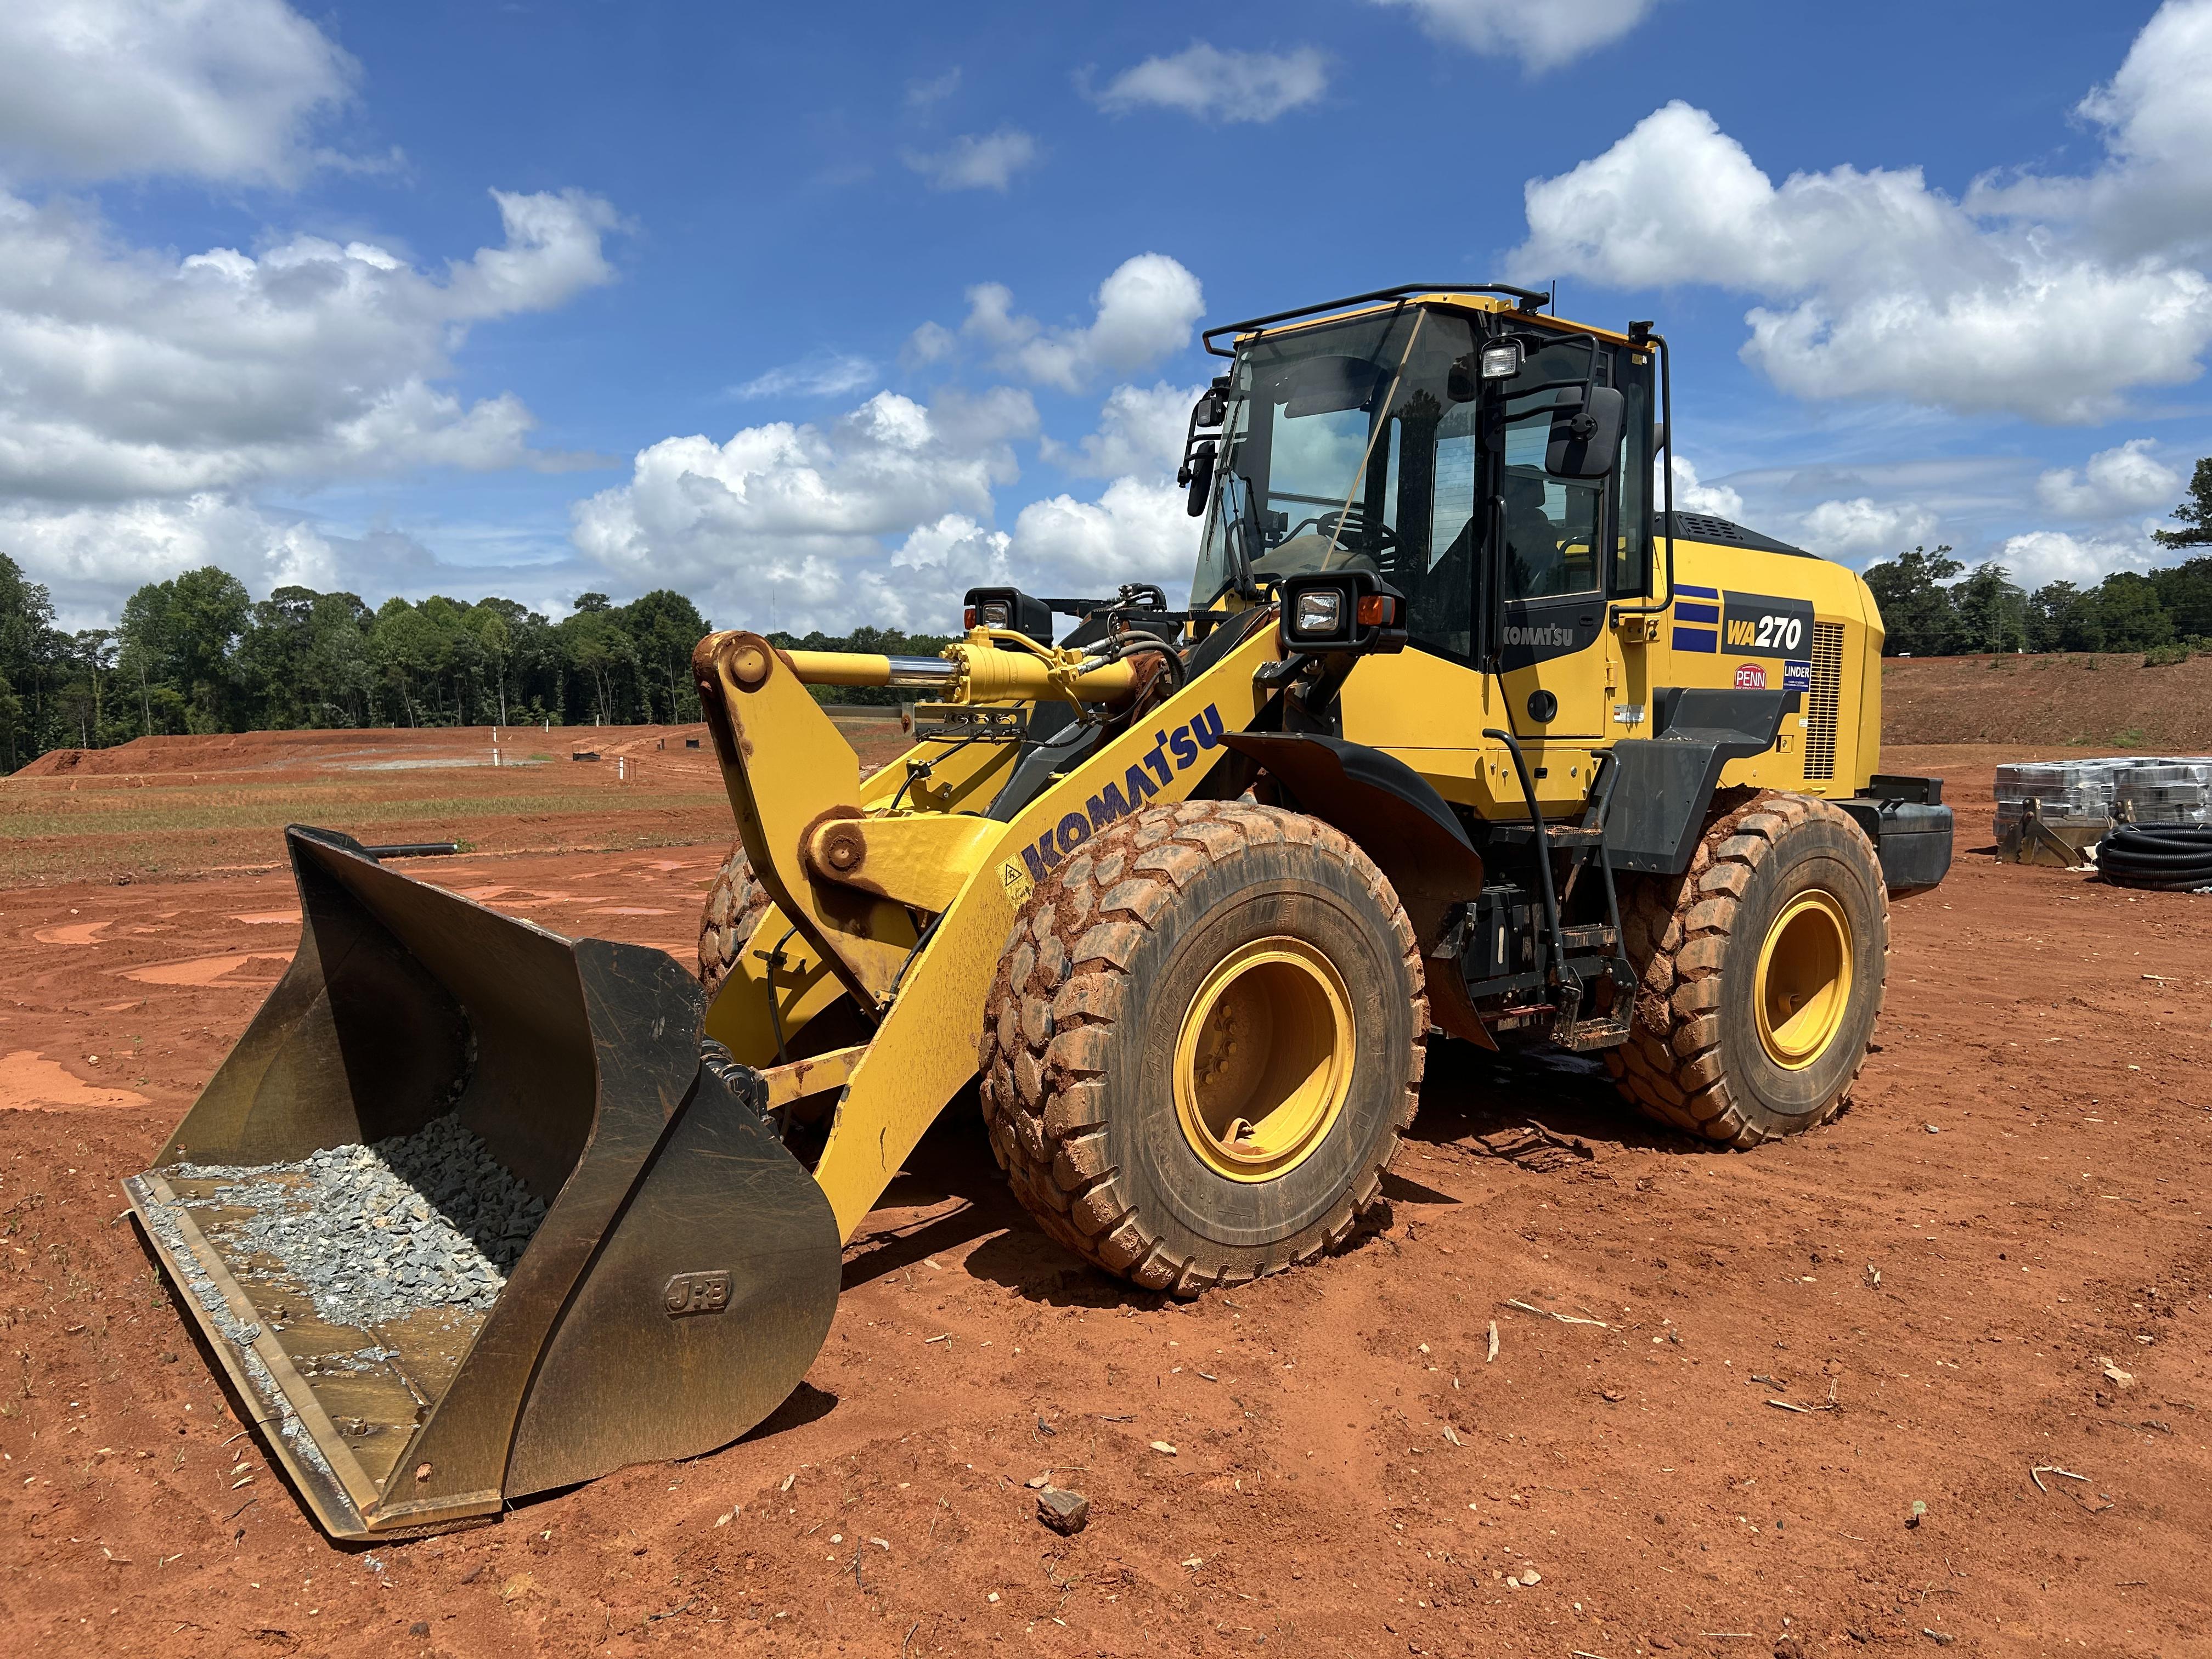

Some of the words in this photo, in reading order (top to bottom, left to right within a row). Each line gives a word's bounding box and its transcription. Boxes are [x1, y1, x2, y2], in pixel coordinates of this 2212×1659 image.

[1727, 615, 1802, 650] WA270
[1736, 670, 1765, 687] PENN
[1784, 665, 1809, 678] LINDER
[1020, 702, 1224, 882] KOMATSU
